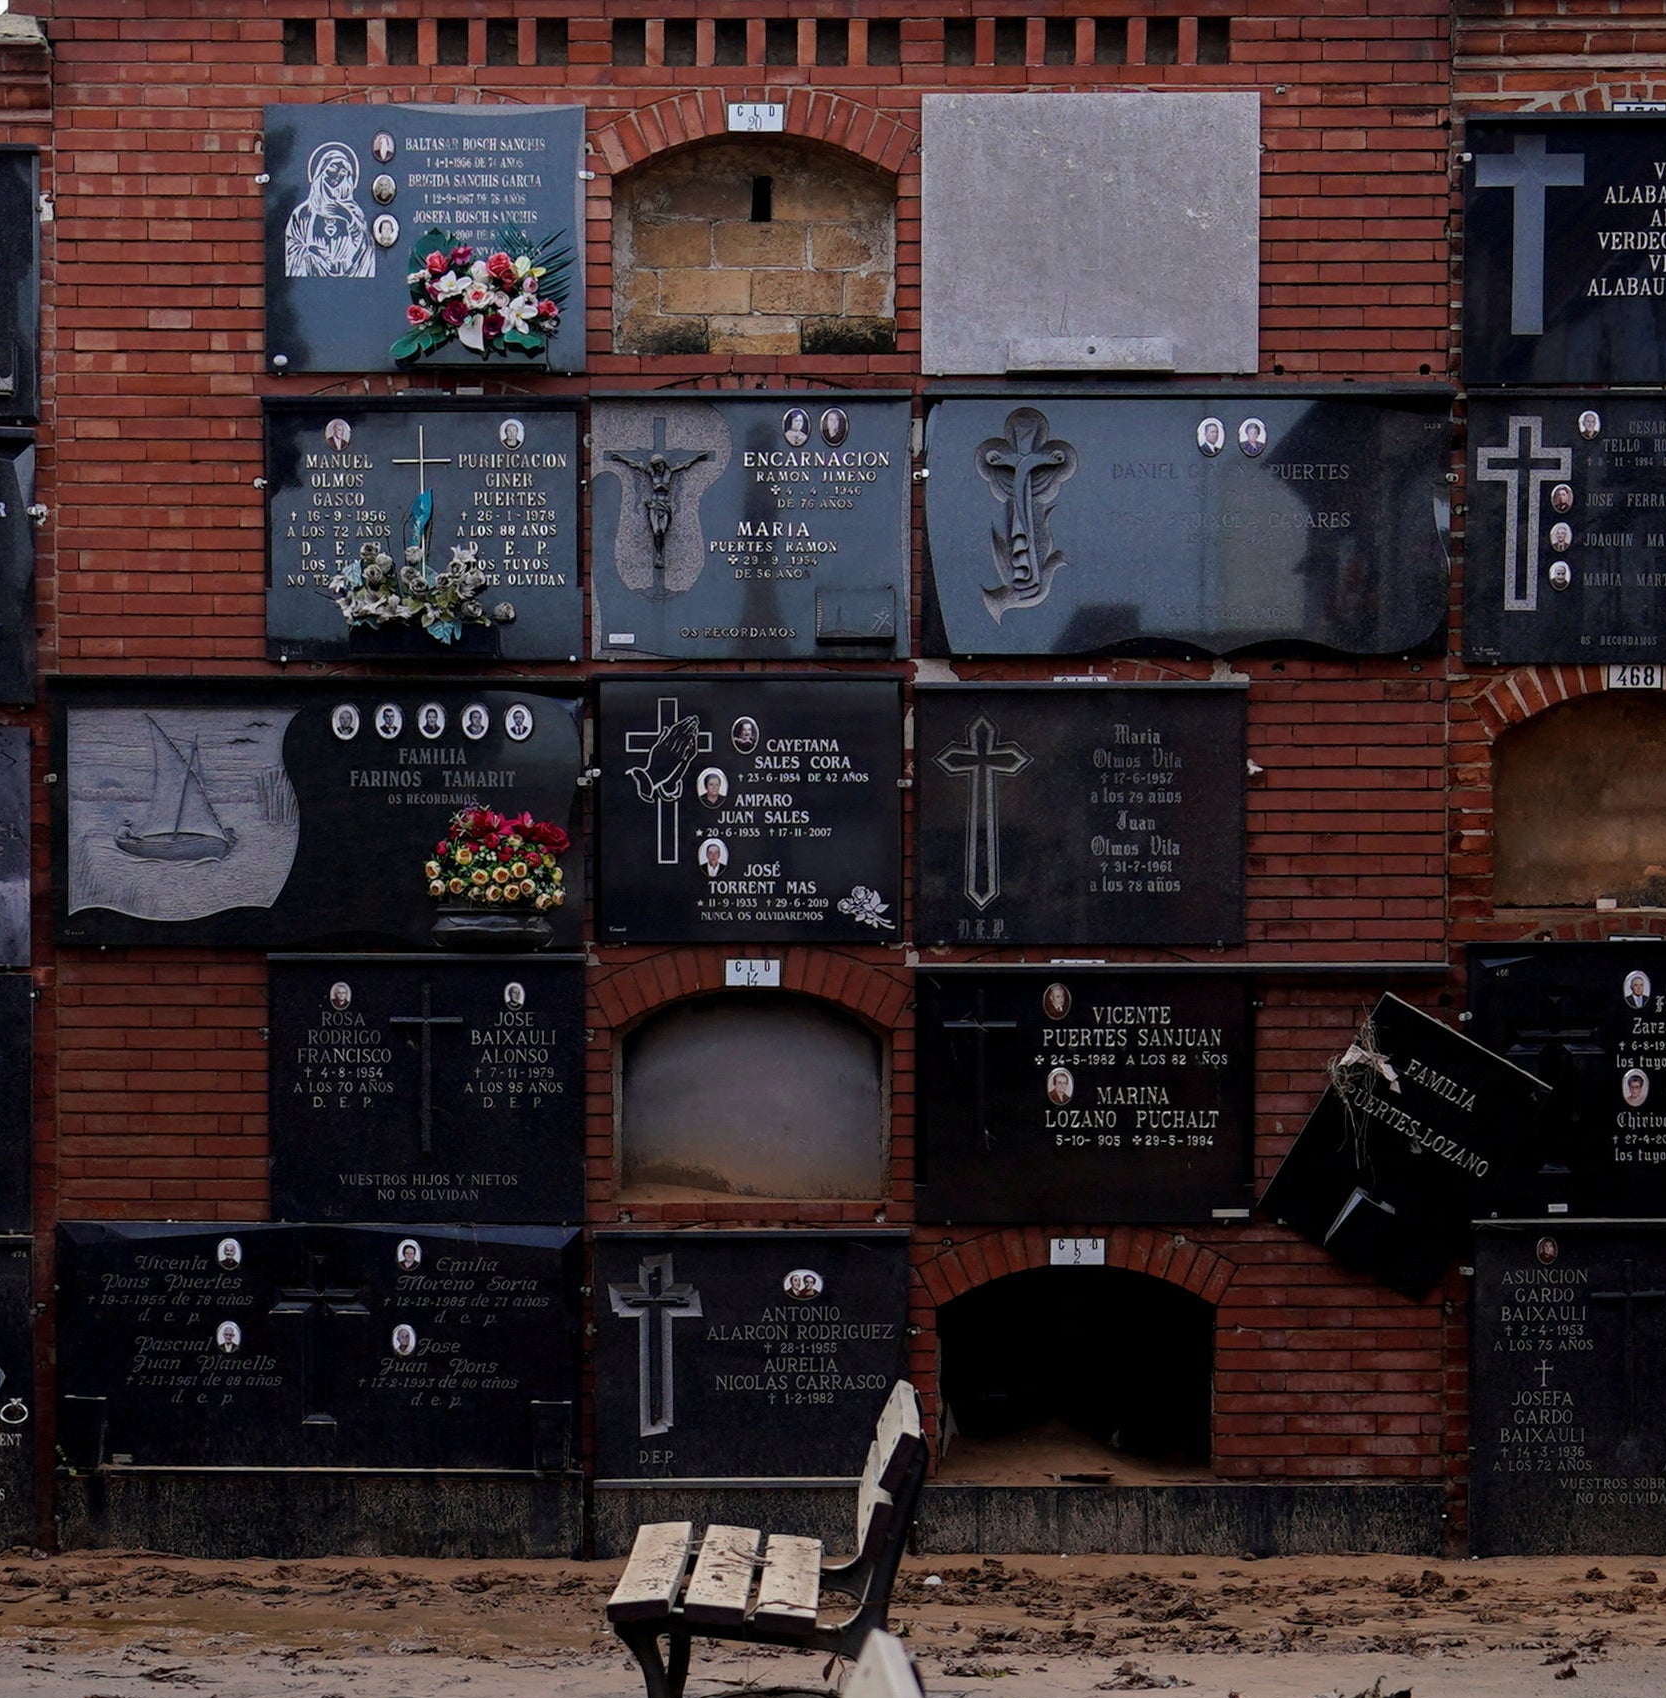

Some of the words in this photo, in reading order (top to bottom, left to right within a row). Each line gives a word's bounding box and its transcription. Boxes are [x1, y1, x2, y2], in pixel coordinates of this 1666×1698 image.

[1586, 277, 1666, 297] ALABAU
[1602, 438, 1640, 453] TELLO
[306, 453, 373, 469] MANUEL
[458, 453, 567, 469] PURIFICACION
[743, 451, 890, 467] ENCARNACION
[311, 472, 364, 488] OLMOS
[485, 472, 533, 488] GINER
[756, 470, 810, 482] RAMON
[313, 492, 365, 507] GASCO
[474, 491, 547, 506] PUERTES
[1585, 492, 1614, 507] JOSE
[737, 521, 810, 537] MARIA
[710, 541, 773, 552] PUERTES
[785, 541, 837, 553] RAMON
[1583, 532, 1634, 547] JOAQUIN
[1583, 572, 1622, 587] MARIA
[1615, 664, 1658, 686] 468
[766, 738, 840, 753] CAYETANA
[398, 747, 467, 765] FAMILIA
[754, 755, 800, 770] SALES
[810, 755, 851, 769] CORA
[442, 770, 516, 788] TAMARIT
[734, 793, 793, 807] AMPARO
[717, 810, 754, 824] JUAN
[764, 810, 810, 824] SALES
[743, 860, 781, 878] JOSÉ
[708, 880, 776, 895] TORRENT
[786, 880, 817, 895] MAS
[321, 1011, 366, 1027] ROSA
[493, 1011, 534, 1027] JOSE
[1092, 1006, 1171, 1025] VICENTE
[308, 1029, 381, 1045] RODRIGO
[471, 1029, 556, 1046] BAIXAULI
[1042, 1028, 1128, 1047] PUERTES
[1137, 1028, 1222, 1047] SANJUAN
[297, 1047, 392, 1064] FRANCISCO
[480, 1048, 549, 1064] ALONSO
[1403, 1058, 1476, 1112] FAMILIA
[1096, 1086, 1170, 1105] MARINA
[1045, 1109, 1117, 1129] LOZANO
[1135, 1110, 1220, 1129] PUCHALT
[1501, 1268, 1588, 1285] ASUNCION
[1514, 1287, 1575, 1303] GARDO
[761, 1305, 841, 1322] ANTONIO
[1500, 1305, 1586, 1322] BAIXAULI
[706, 1324, 789, 1341] ALARCON
[796, 1323, 894, 1340] RODRIGUEZ
[763, 1356, 839, 1373] AURELIA
[715, 1374, 788, 1391] NICOLAS
[795, 1374, 887, 1391] CARRASCO
[1511, 1390, 1574, 1406] JOSEFA
[1513, 1408, 1573, 1425] GARDO
[1500, 1427, 1585, 1443] BAIXAULI
